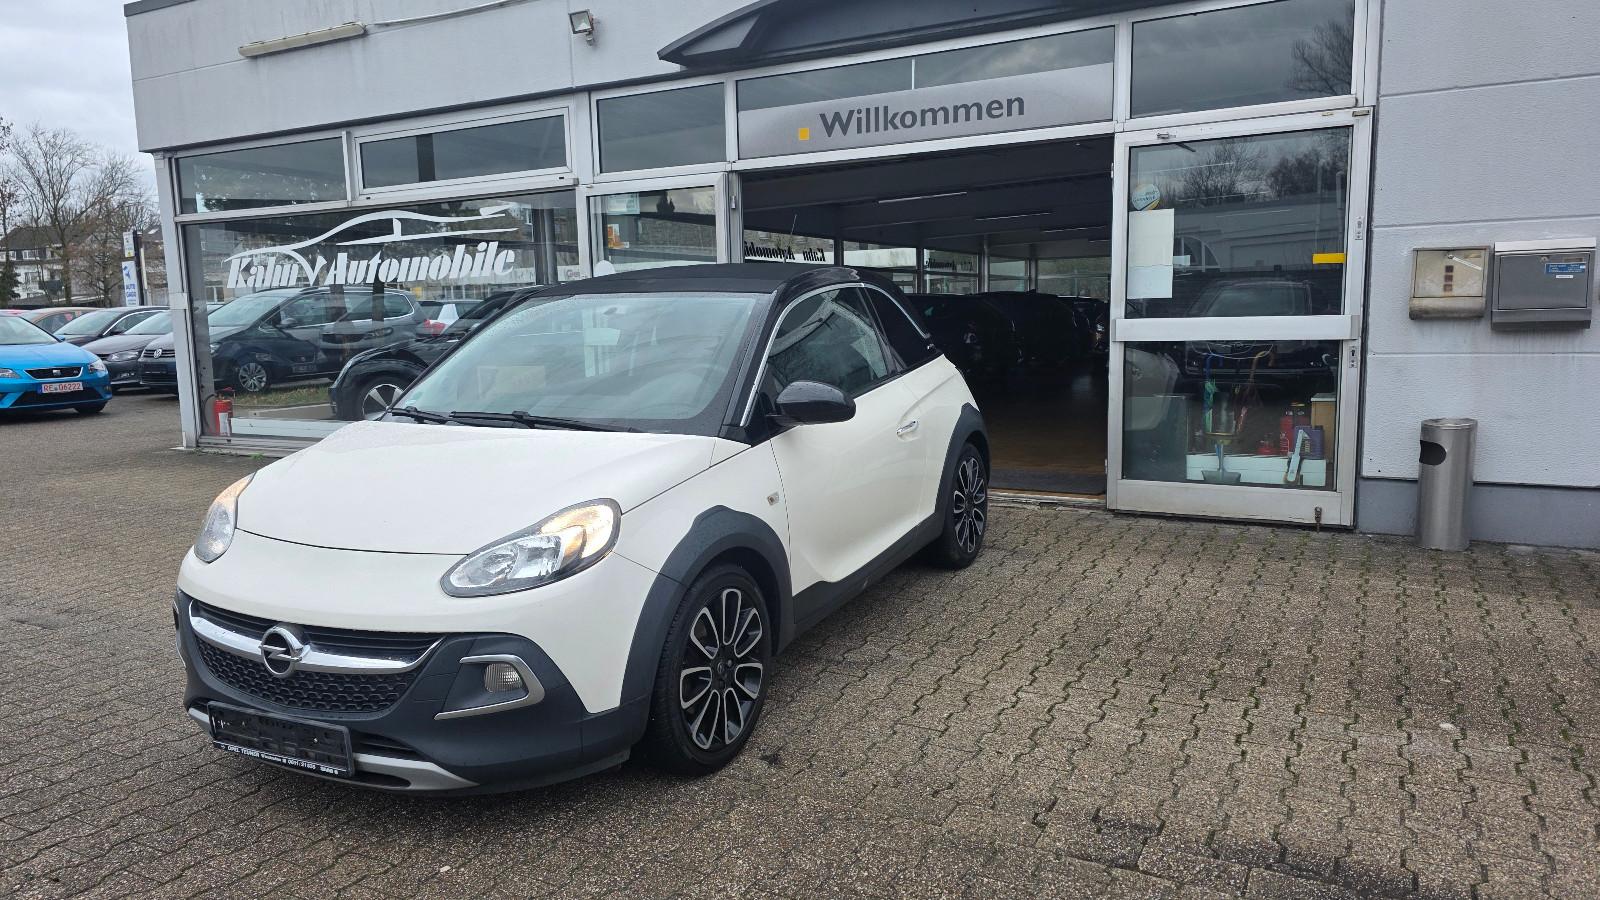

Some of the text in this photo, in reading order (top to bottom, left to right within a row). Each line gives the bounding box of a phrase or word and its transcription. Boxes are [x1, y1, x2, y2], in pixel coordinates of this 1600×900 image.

[819, 96, 1025, 138] Willkommen
[226, 241, 515, 289] Kahn Automobile
[43, 384, 54, 392] RE
